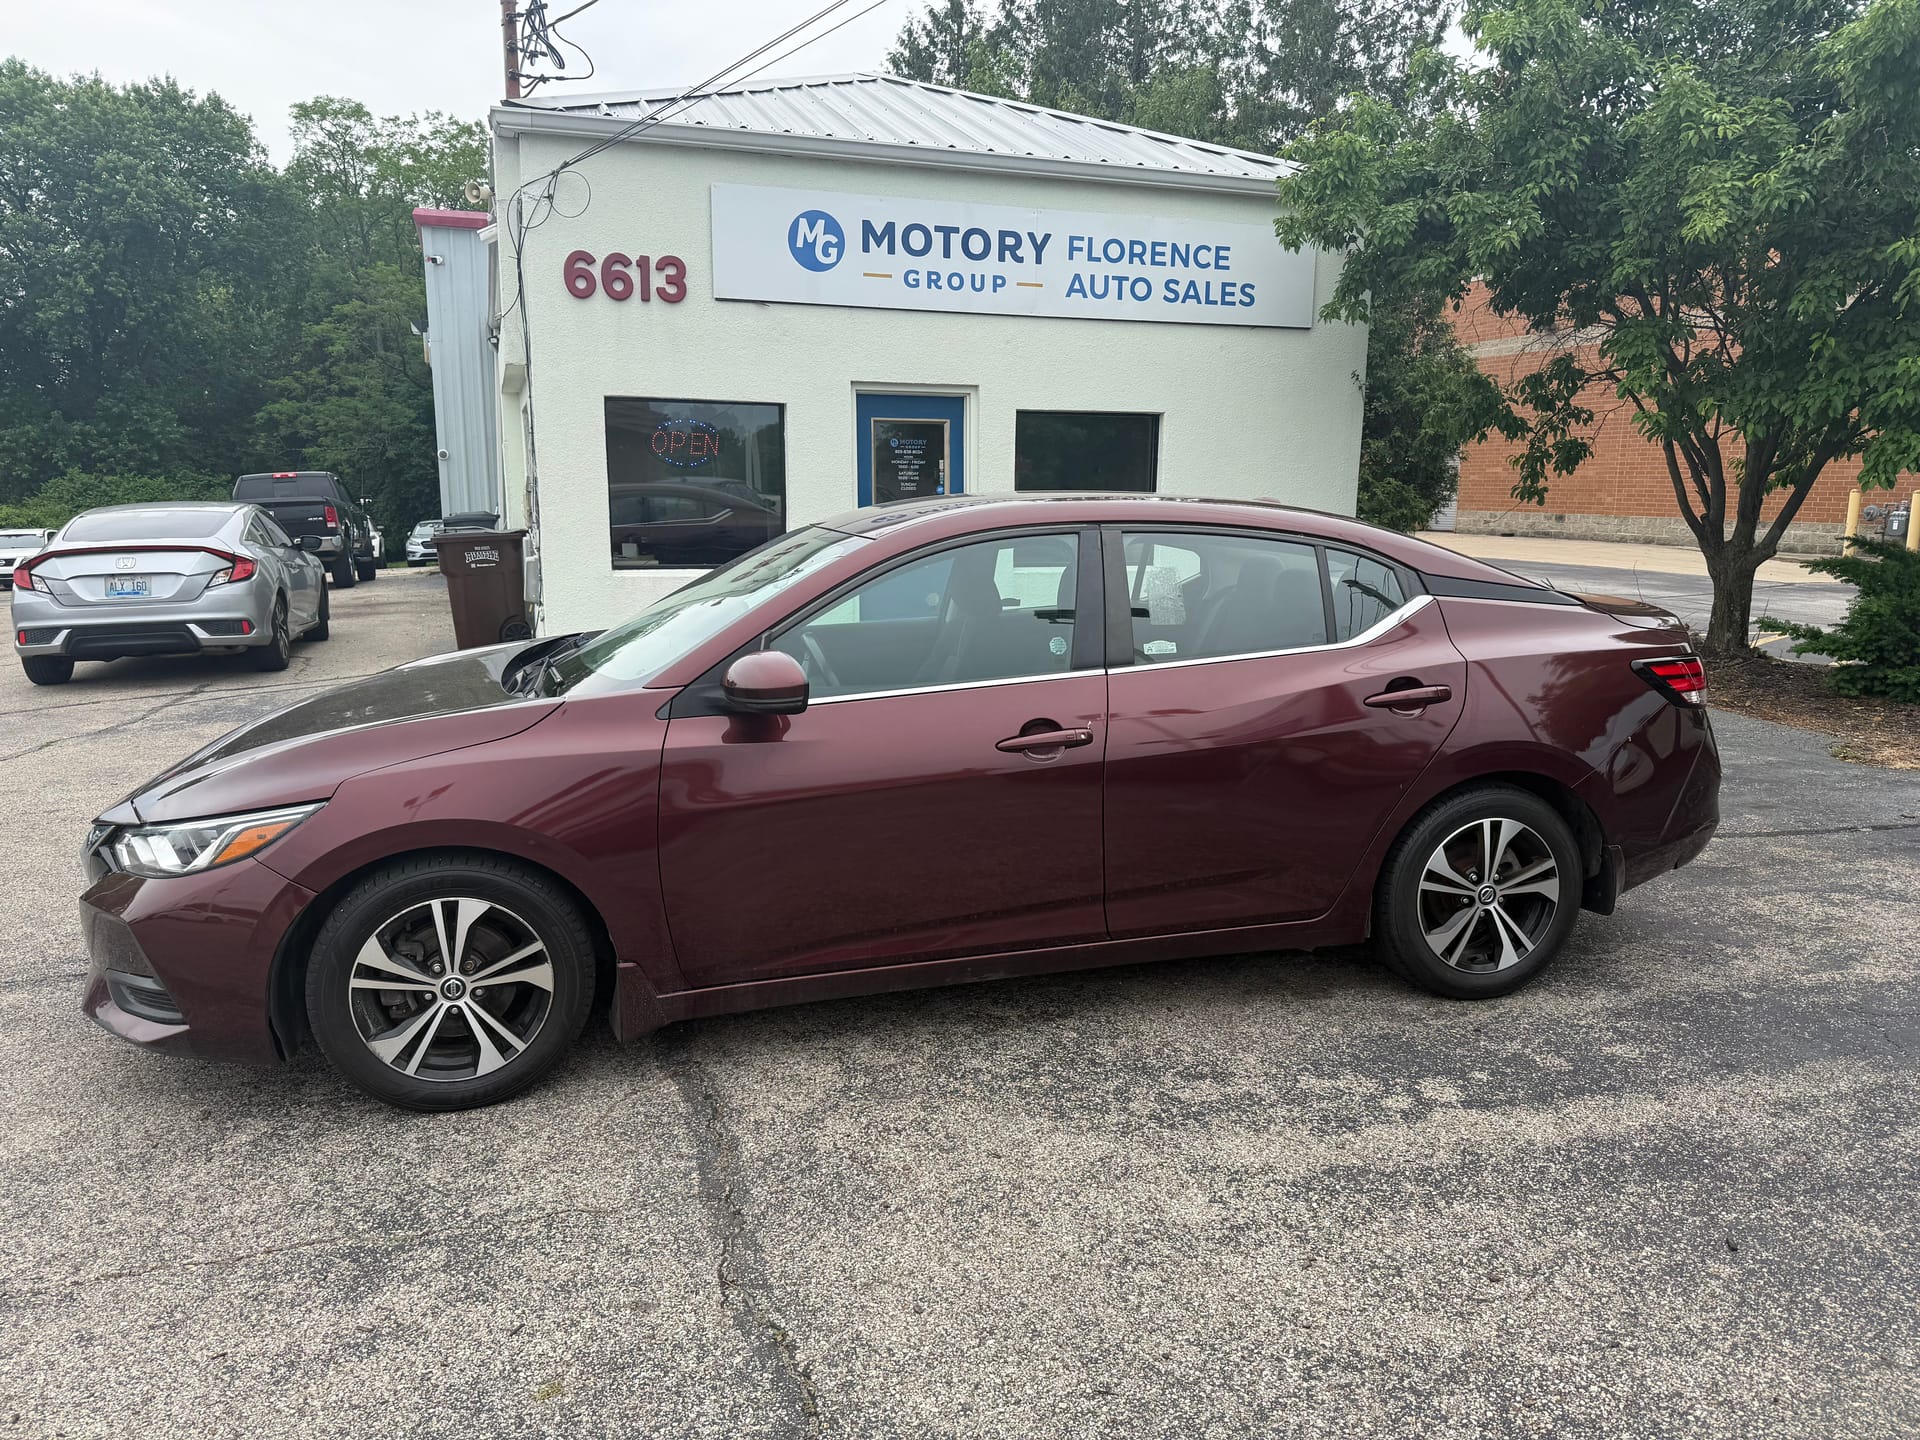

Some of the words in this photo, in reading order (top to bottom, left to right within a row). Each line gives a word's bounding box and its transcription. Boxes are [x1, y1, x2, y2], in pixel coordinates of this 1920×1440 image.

[795, 217, 839, 264] MG
[862, 220, 1051, 264] MOTORY
[1067, 236, 1231, 270] FLORENCE
[562, 249, 688, 302] 6613
[903, 268, 1007, 293] GROUP
[1065, 273, 1153, 303] AUTO
[1163, 278, 1256, 307] SALES
[651, 431, 720, 456] OPEN
[109, 581, 125, 593] ALX
[132, 580, 147, 592] 160
